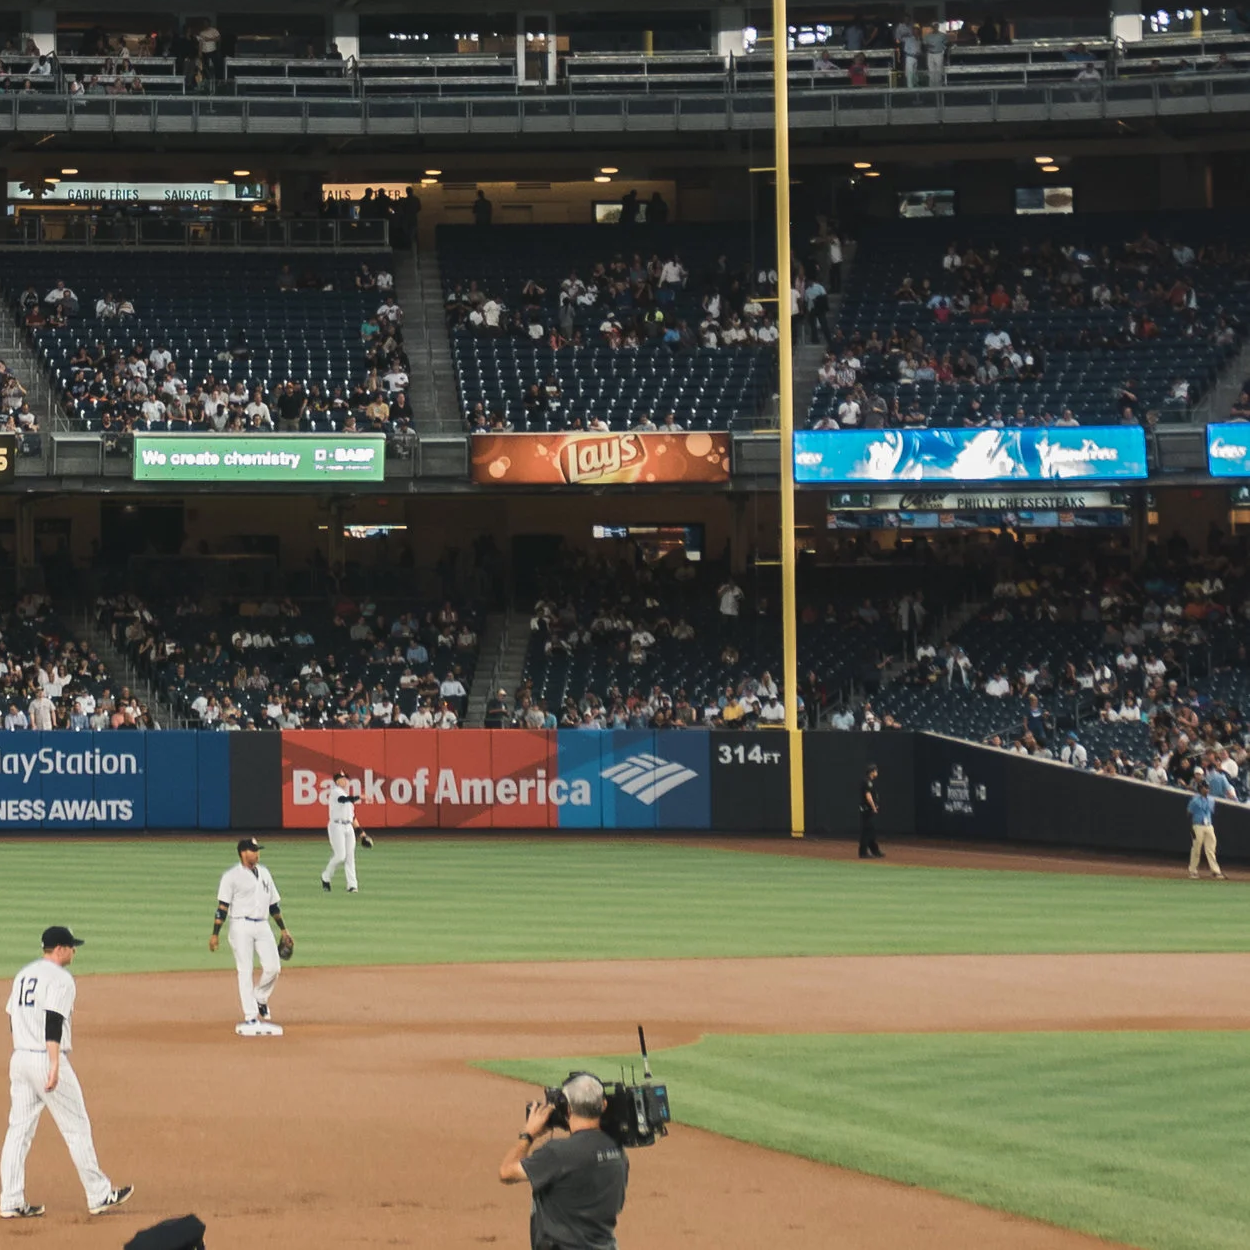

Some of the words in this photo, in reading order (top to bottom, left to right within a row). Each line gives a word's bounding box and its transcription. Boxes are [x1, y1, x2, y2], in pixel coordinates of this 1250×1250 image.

[67, 189, 106, 200] GARLIC
[110, 189, 139, 200] FRIES
[164, 190, 212, 200] SAUSAGE
[142, 450, 167, 465] We
[170, 451, 220, 465] create
[224, 450, 300, 468] chemistry
[566, 434, 639, 483] Lay's
[998, 497, 1086, 510] CHEESESTEAKS
[390, 768, 431, 805] of
[434, 768, 592, 806] America
[48, 798, 134, 822] AWAITS
[18, 976, 38, 1007] 12
